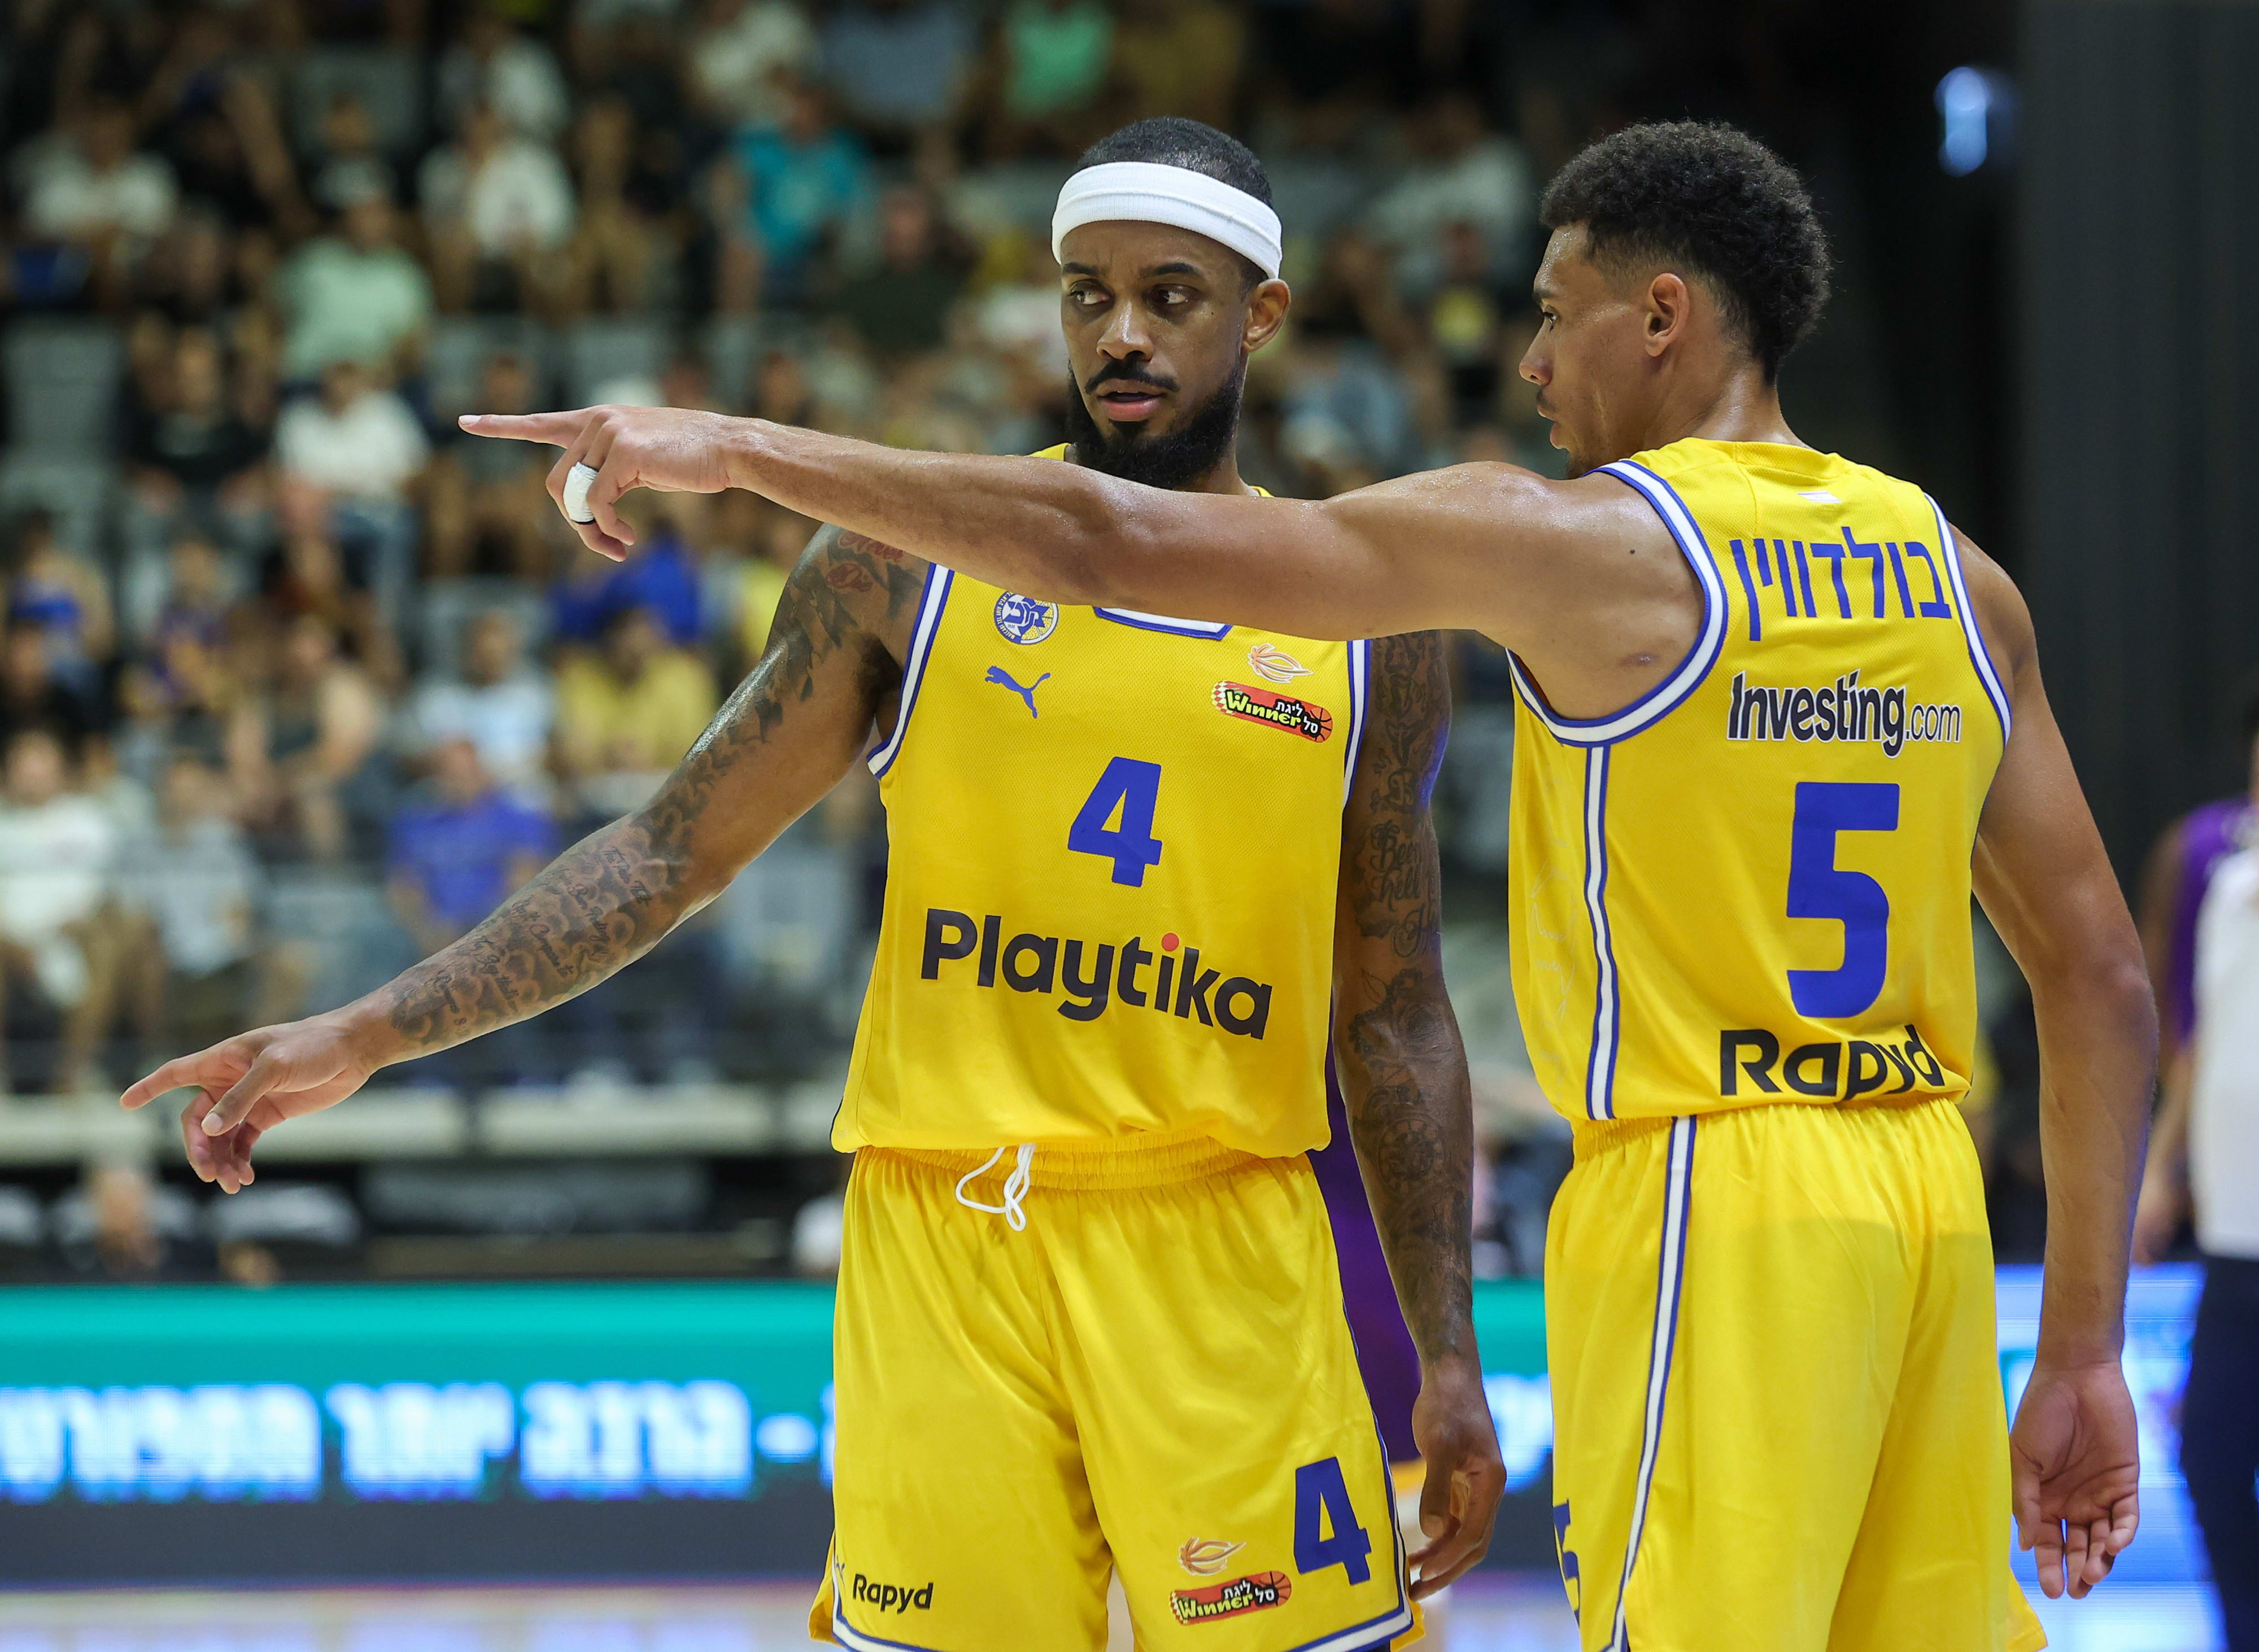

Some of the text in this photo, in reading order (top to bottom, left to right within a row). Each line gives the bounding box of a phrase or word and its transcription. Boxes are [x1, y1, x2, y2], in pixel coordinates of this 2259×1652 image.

[1729, 526, 1952, 641] בולדווין
[1226, 690, 1302, 727] Winner
[1275, 701, 1303, 716] ליגת
[1303, 716, 1319, 734] סל
[1727, 668, 1962, 758] Investing.com
[1067, 756, 1162, 887] 4
[1786, 782, 1900, 1018] 5
[921, 907, 1274, 1040] Playtika
[1720, 1024, 1945, 1100] Rapyd
[1294, 1456, 1372, 1586] 4
[853, 1573, 934, 1615] Rapyd
[1178, 1593, 1253, 1619] Winner
[1224, 1580, 1250, 1599] ליגת
[1255, 1587, 1275, 1603] סל
